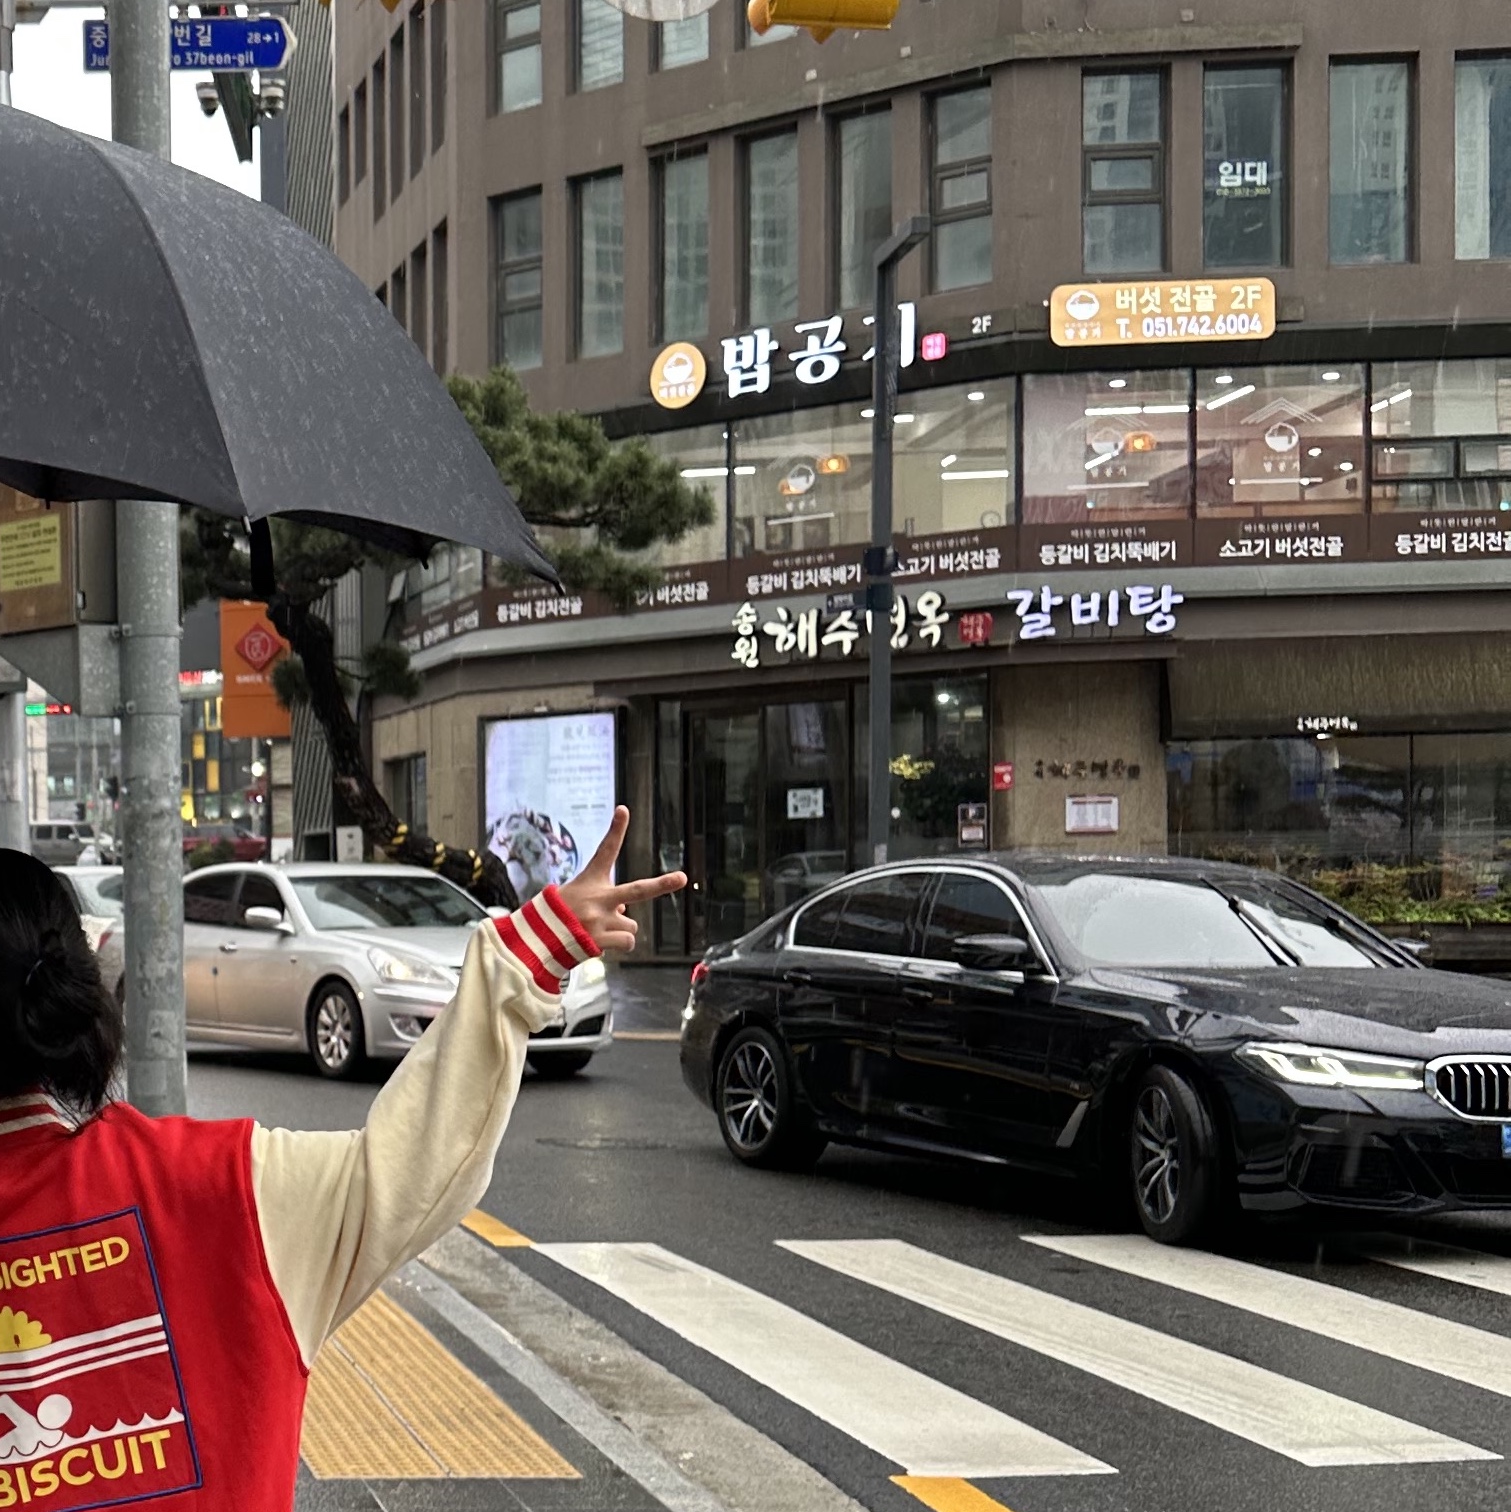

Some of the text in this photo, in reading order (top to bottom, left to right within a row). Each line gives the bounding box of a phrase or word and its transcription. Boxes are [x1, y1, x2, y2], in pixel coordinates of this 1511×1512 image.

[172, 24, 212, 47] 번길
[1218, 161, 1267, 187] 임대
[1115, 284, 1262, 315] 버섯 전골 2F
[972, 315, 992, 335] 2F
[1116, 313, 1263, 339] T. 051.742.6004
[1039, 543, 1089, 565] 등갈비
[1219, 536, 1343, 559] 소고기 버섯전골
[1394, 533, 1446, 555] 등갈비
[1006, 584, 1184, 640] 갈비탕
